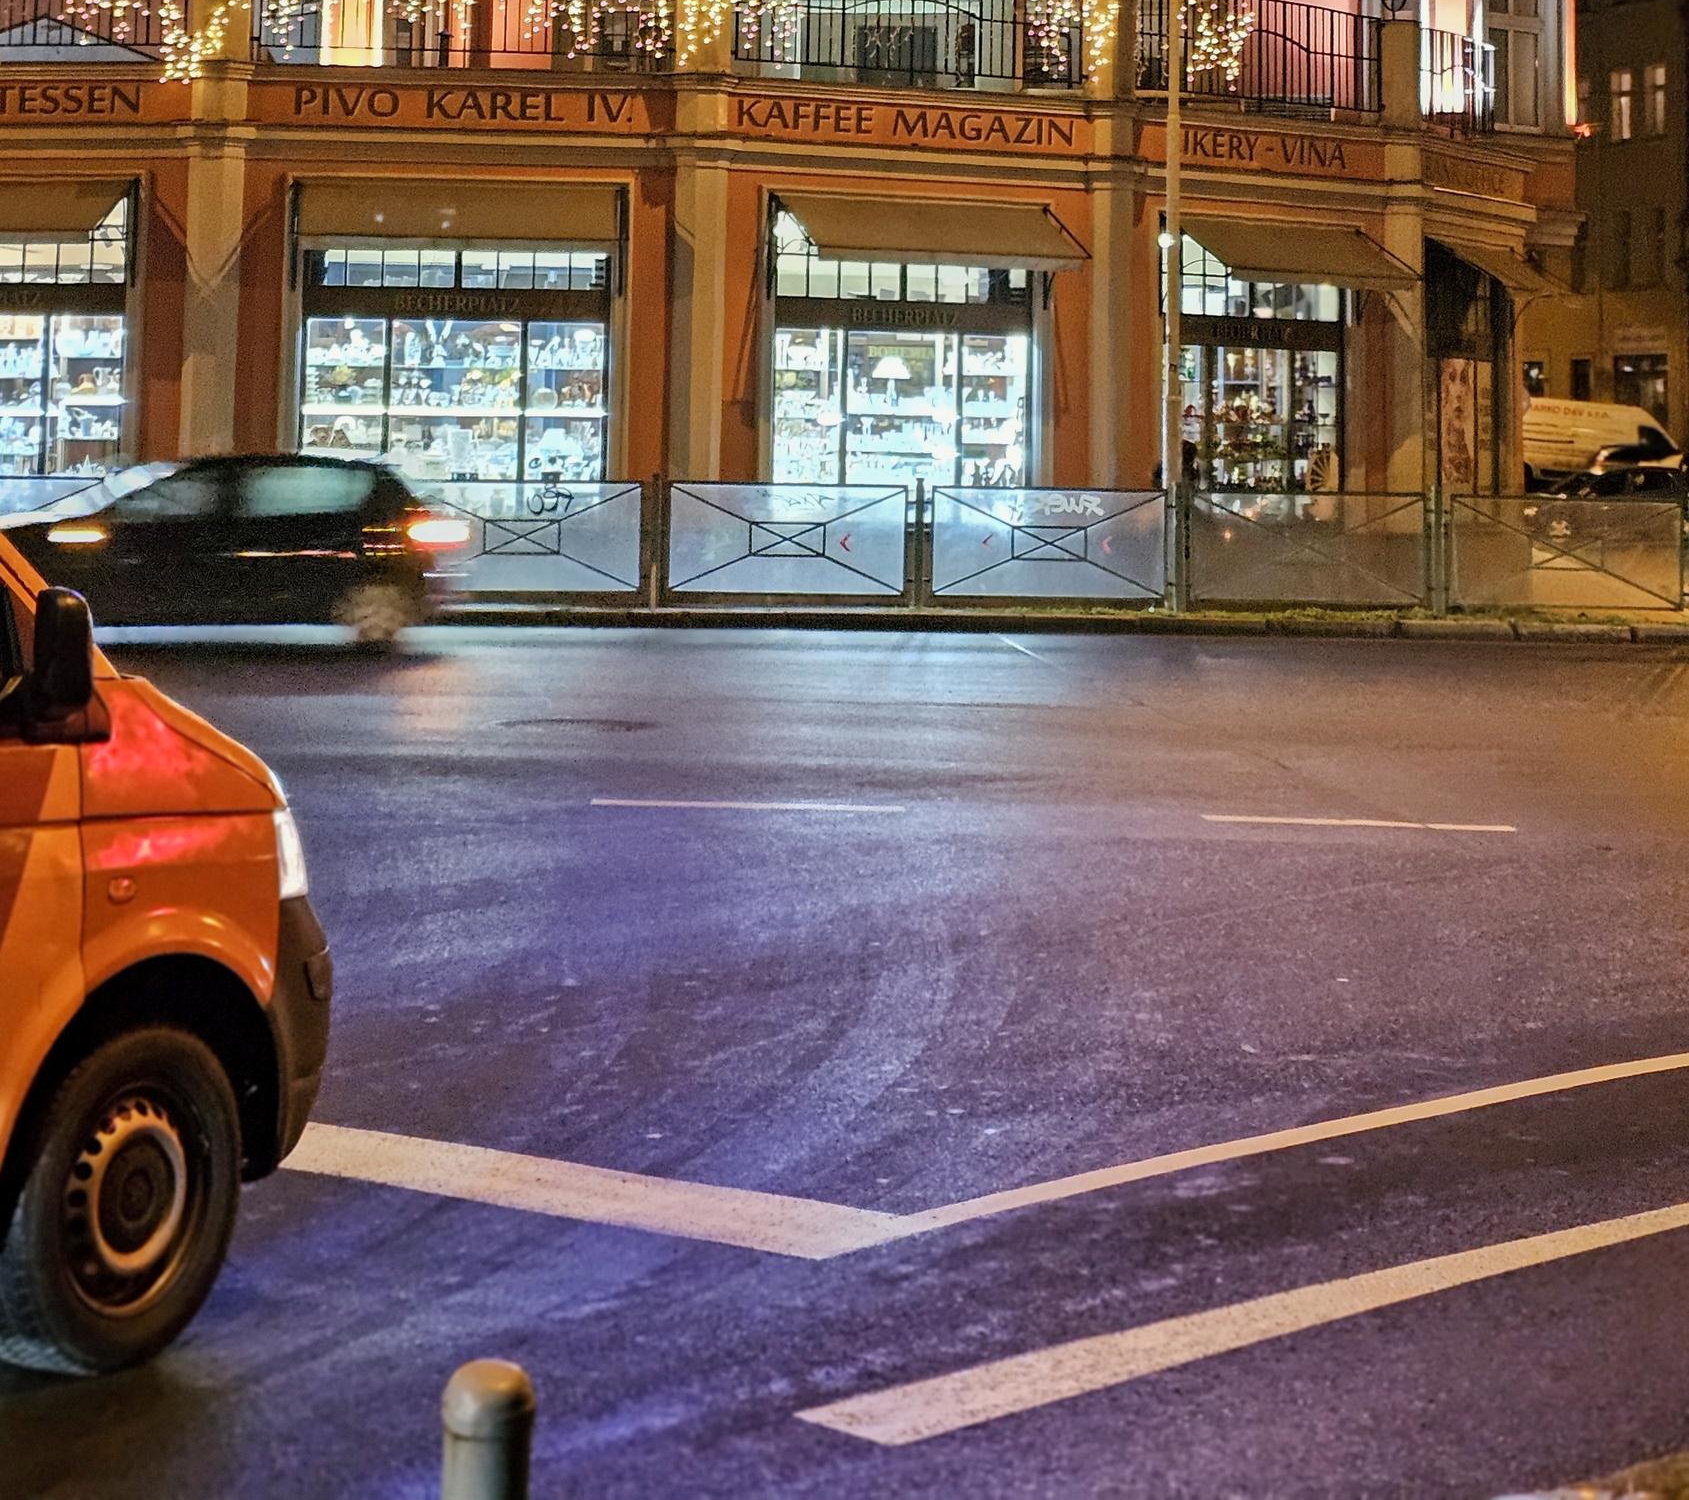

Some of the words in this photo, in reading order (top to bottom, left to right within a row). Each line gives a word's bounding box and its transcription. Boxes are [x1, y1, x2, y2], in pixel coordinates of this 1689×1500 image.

[293, 86, 400, 117] PIVO
[426, 89, 565, 122] KAREL
[587, 91, 634, 123] IV.
[736, 99, 874, 135] KAFFEE
[892, 109, 1075, 147] MAGAZIN
